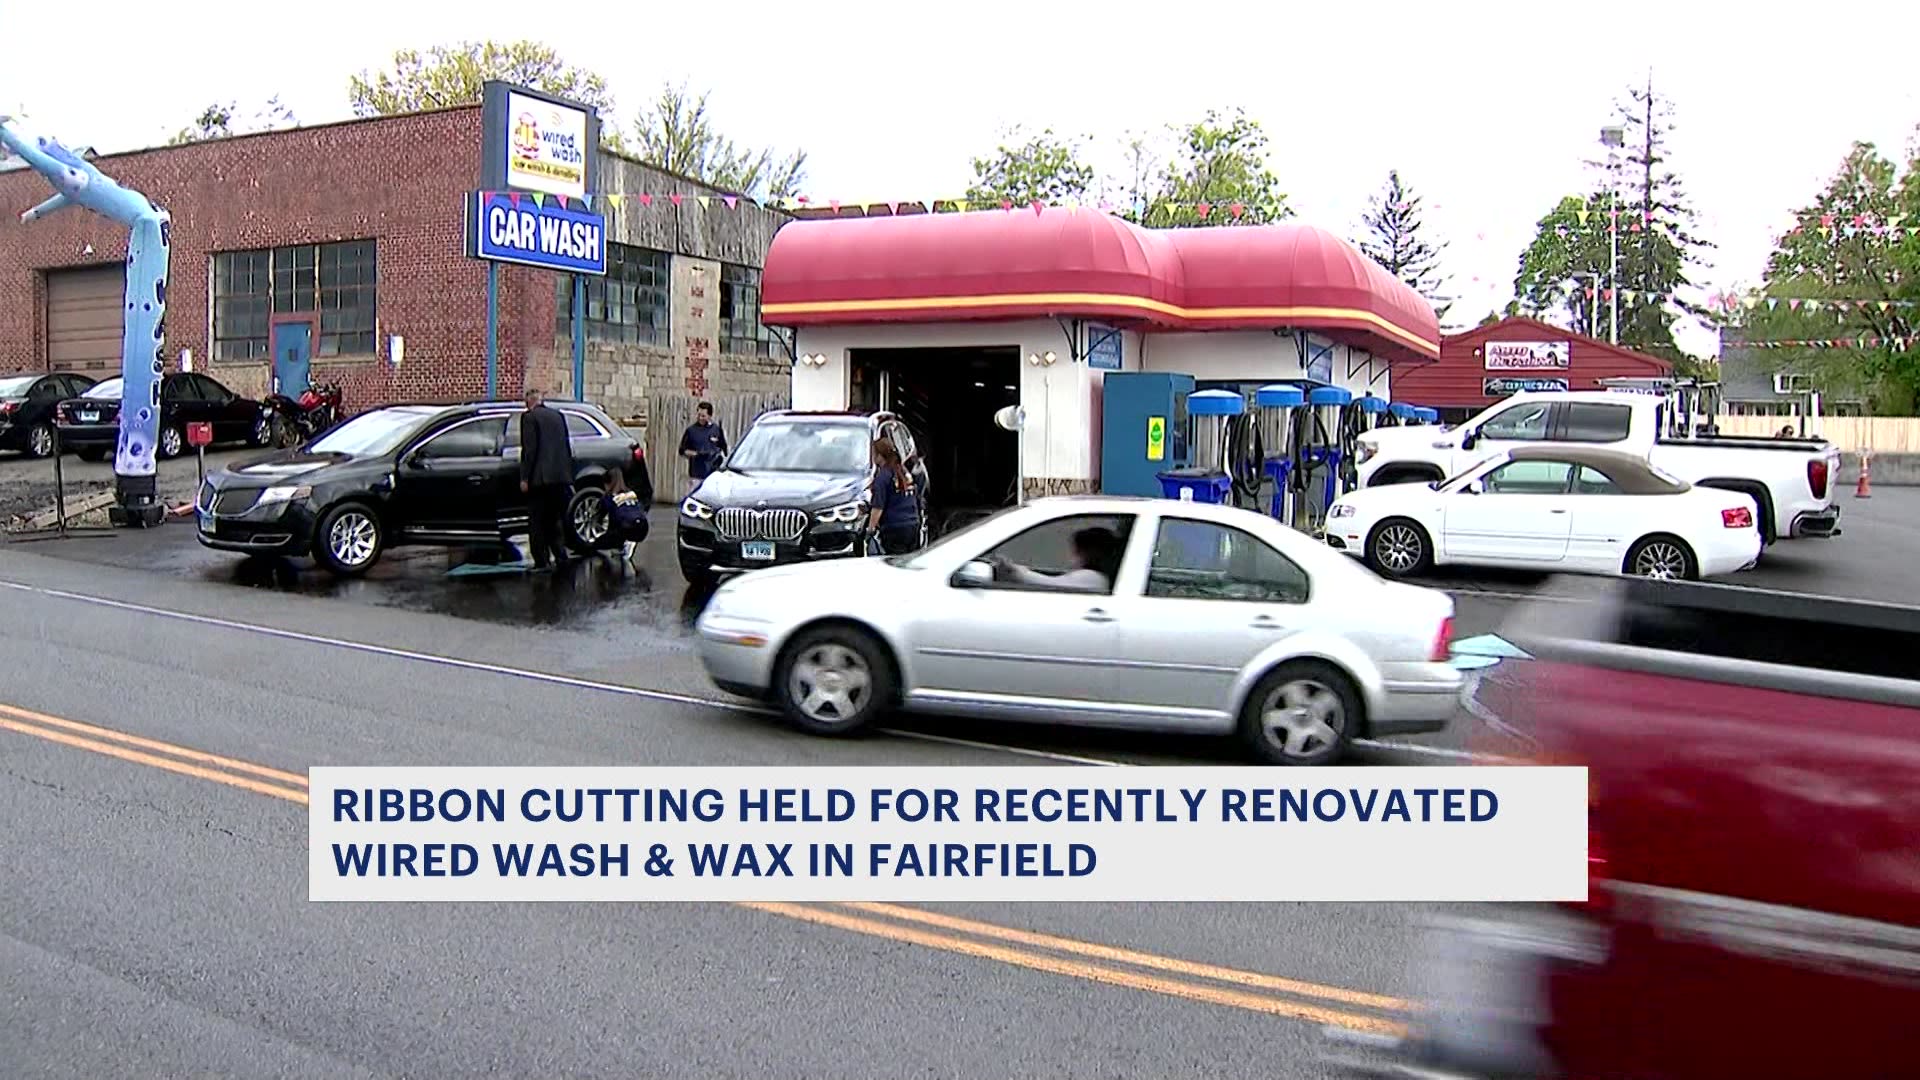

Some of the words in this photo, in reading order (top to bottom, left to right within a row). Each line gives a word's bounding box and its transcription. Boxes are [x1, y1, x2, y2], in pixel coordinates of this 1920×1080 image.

[542, 130, 575, 148] wired
[551, 147, 582, 164] wash
[489, 207, 537, 252] CAR
[540, 214, 600, 261] WASH
